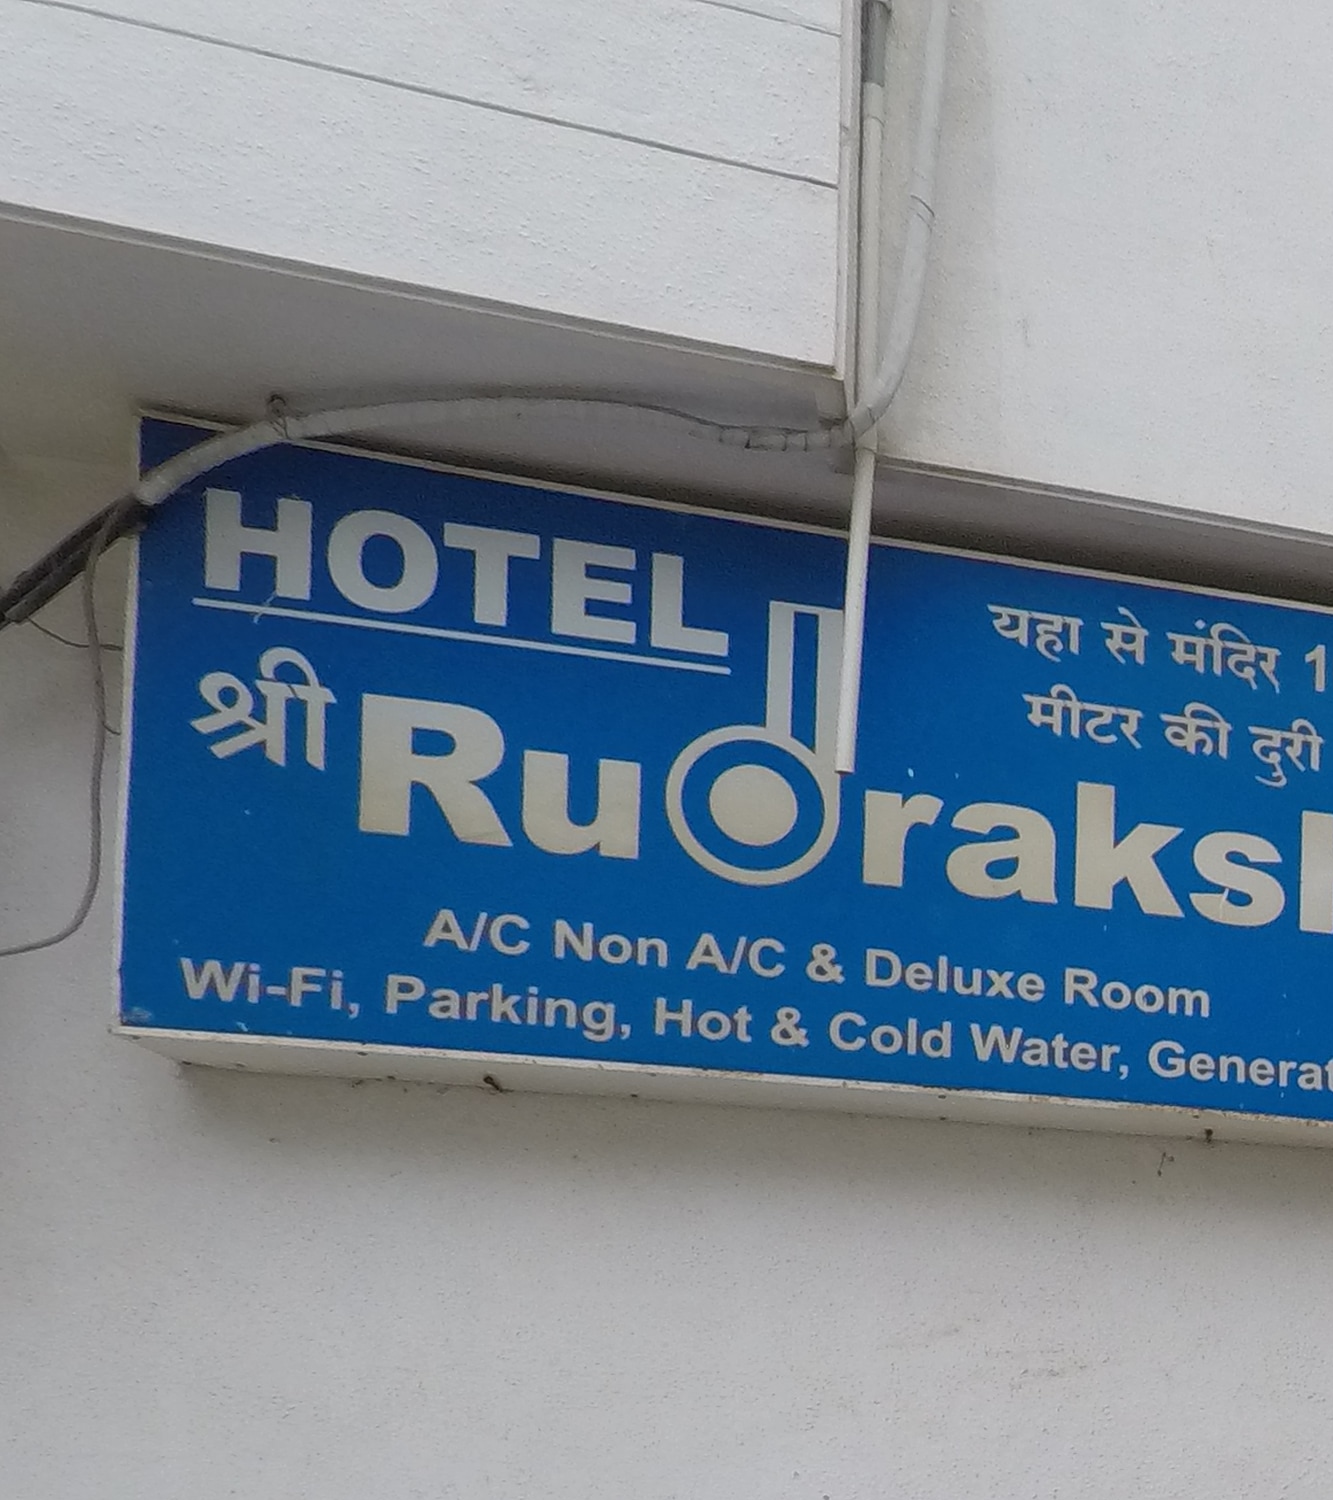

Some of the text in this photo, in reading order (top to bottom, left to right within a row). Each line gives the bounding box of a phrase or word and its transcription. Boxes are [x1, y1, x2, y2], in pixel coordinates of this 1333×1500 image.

[203, 488, 730, 658] HOTEL
[987, 603, 1084, 661] यहा
[1101, 605, 1149, 666] से
[1166, 619, 1281, 693] मंदिर
[189, 645, 338, 772] श्री
[1023, 683, 1143, 749] मीटर
[1160, 701, 1233, 760] की
[1248, 718, 1325, 788] दुरी
[180, 957, 361, 1018] Wi-Fi,
[384, 973, 632, 1043] Parking,
[653, 998, 753, 1043] Hot
[770, 1007, 809, 1048] &
[828, 1011, 953, 1059] Cold
[968, 1023, 1129, 1080] Water,
[423, 908, 1211, 1018] A/C Non A/C & Deluxe Room
